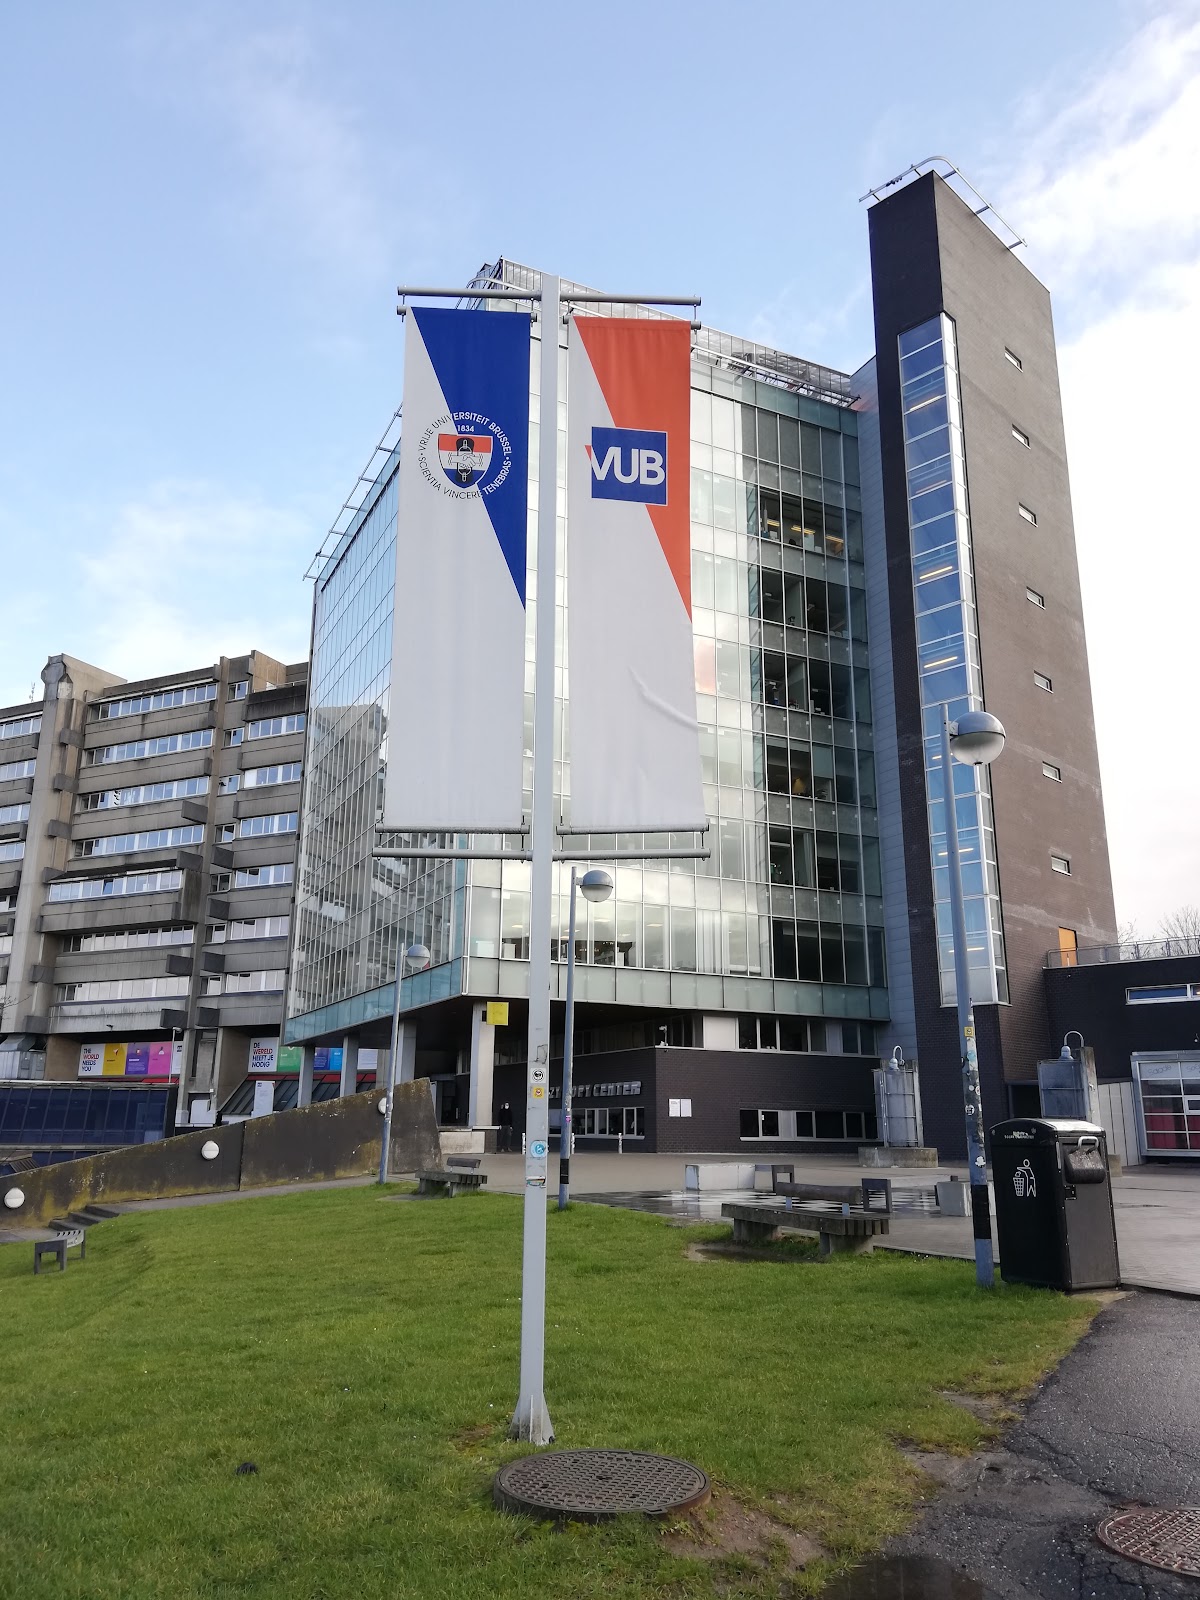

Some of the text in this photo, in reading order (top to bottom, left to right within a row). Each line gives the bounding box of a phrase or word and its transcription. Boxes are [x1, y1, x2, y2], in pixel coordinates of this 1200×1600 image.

[419, 411, 513, 456] VRIJE UNIVERSITEIT BRUSSEL
[418, 456, 512, 500] SCIENTIA VINCERE TENEBRAS
[584, 444, 666, 486] VUB
[593, 1081, 642, 1097] CENTER
